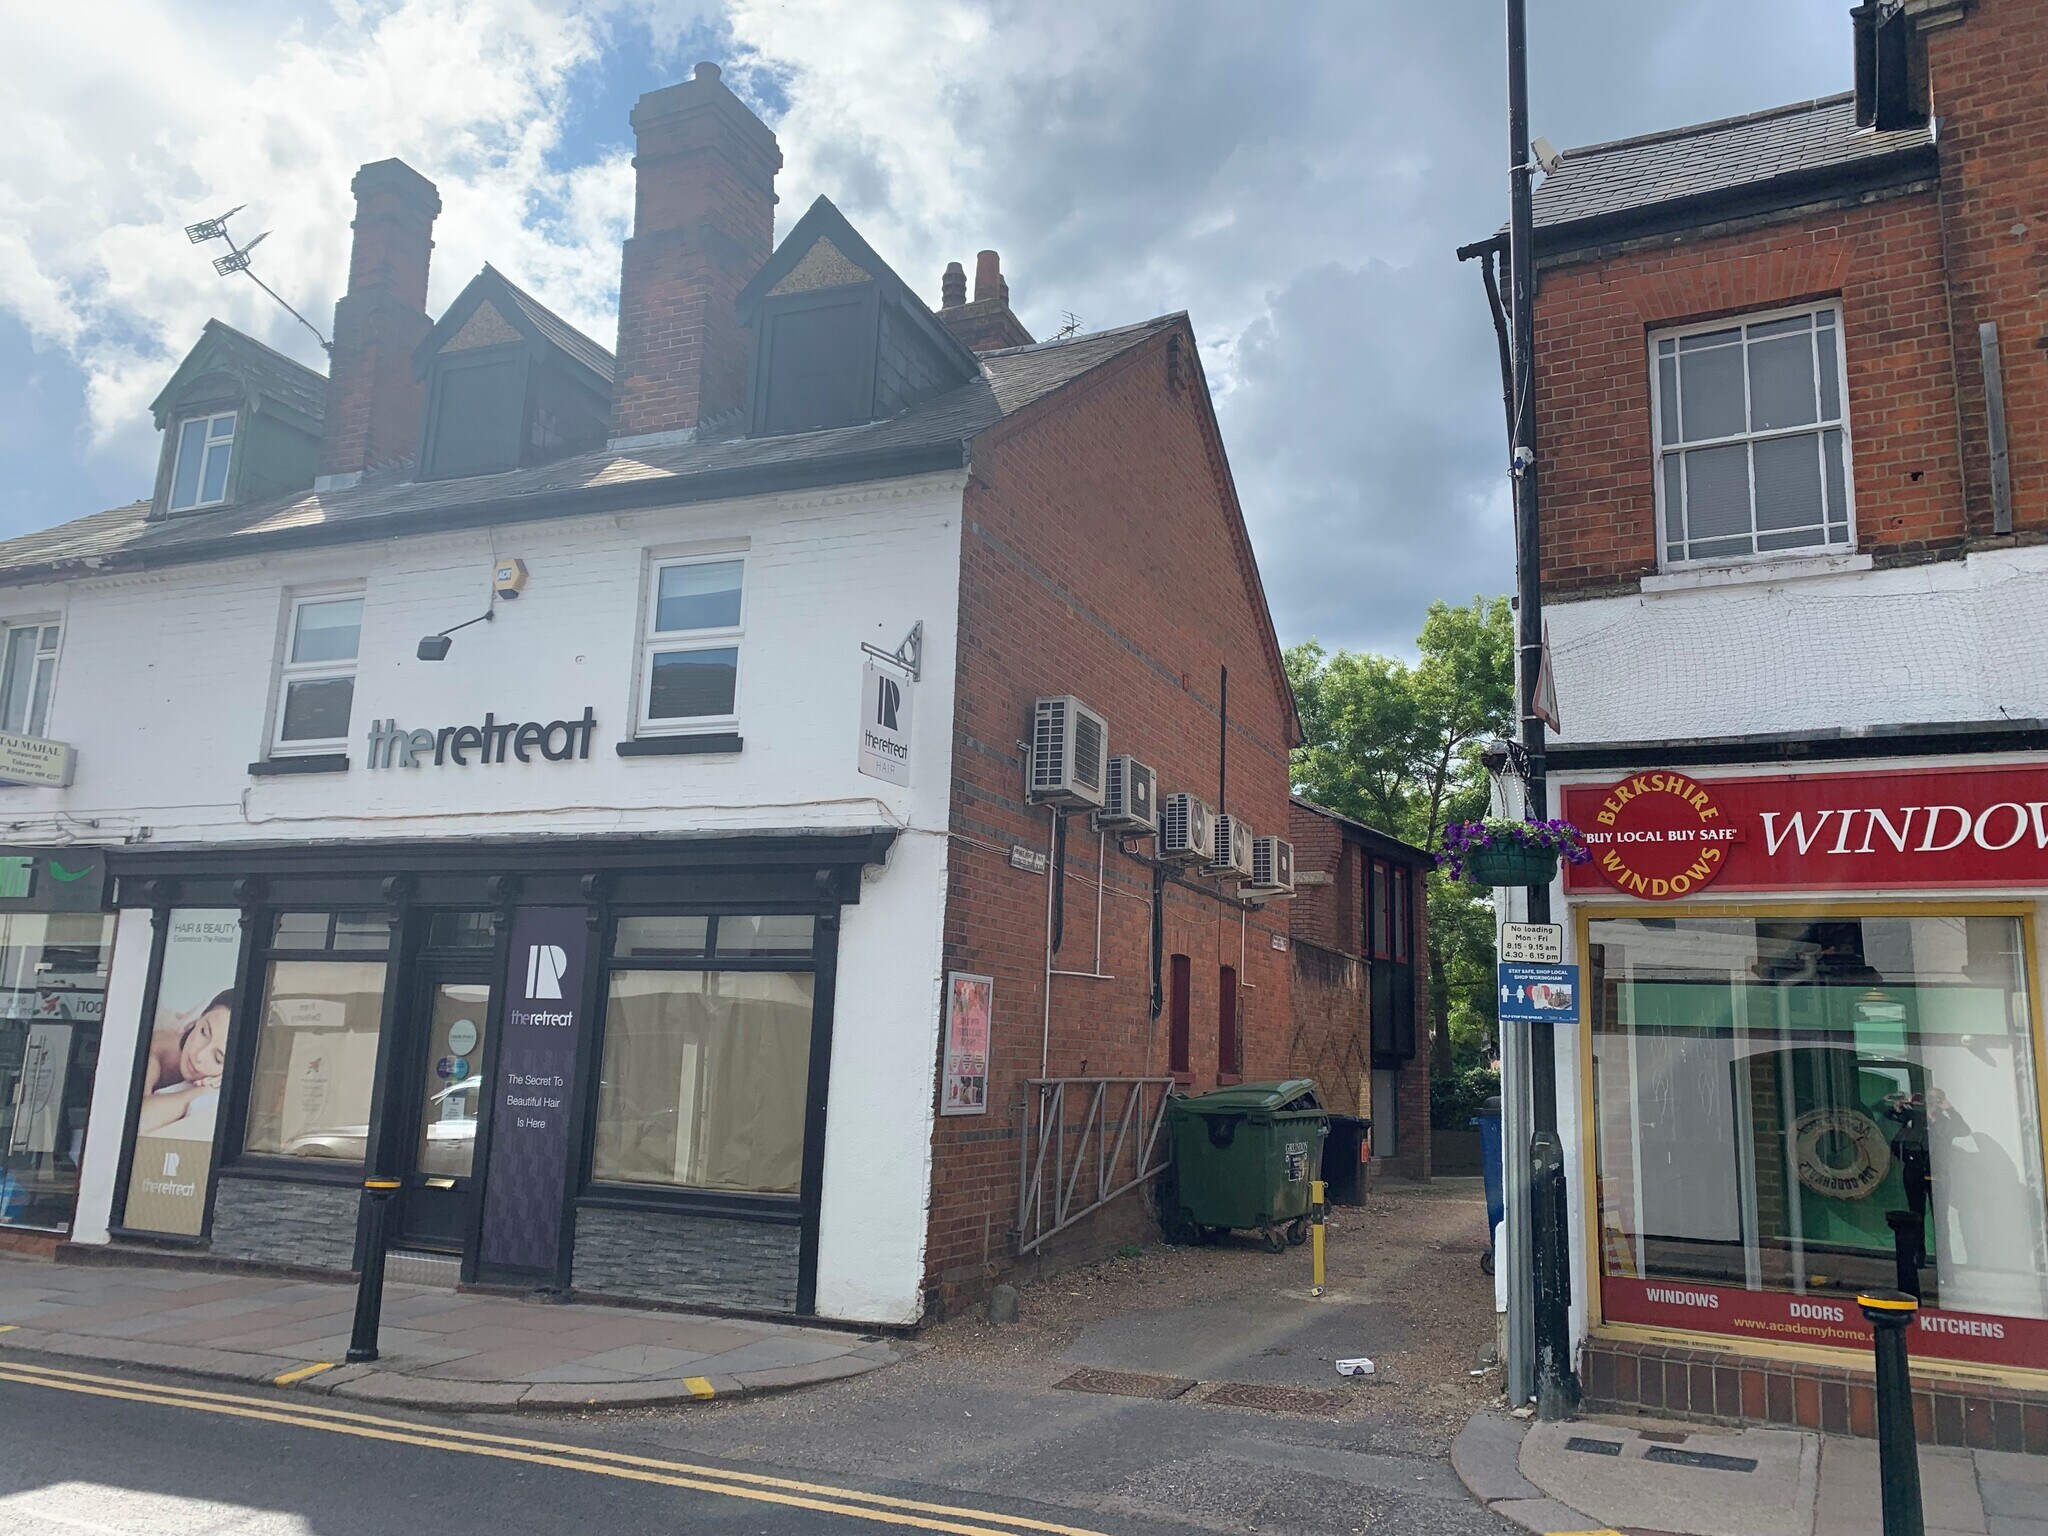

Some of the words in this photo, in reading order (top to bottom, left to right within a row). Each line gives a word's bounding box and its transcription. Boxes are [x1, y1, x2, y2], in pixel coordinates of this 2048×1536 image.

[496, 569, 512, 580] ADT
[0, 737, 18, 748] TAJ
[21, 740, 60, 756] MAHAL
[7, 748, 42, 760] Restaurant
[12, 758, 42, 769] Takeaway
[875, 760, 896, 776] HAIR
[1597, 774, 1719, 826] BERKSHIRE
[1617, 831, 1664, 843] LOCAL
[1668, 830, 1696, 842] BUY
[1602, 846, 1721, 897] WINDOWS
[175, 923, 195, 933] HAIR
[195, 923, 202, 934] &
[203, 923, 237, 934] BEAUTY
[1524, 925, 1553, 934] loading
[1528, 943, 1543, 951] 9.15
[1505, 951, 1523, 959] 4.30
[1529, 952, 1545, 960] 6.15
[508, 1074, 523, 1085] The
[525, 1074, 551, 1087] Secret
[553, 1076, 564, 1087] To
[507, 1095, 542, 1107] Beautiful
[543, 1097, 560, 1108] Hair
[517, 1117, 524, 1127] Is
[526, 1117, 546, 1129] Here
[1645, 1287, 1719, 1309] WINDOWS
[1790, 1303, 1844, 1322] DOORS
[1920, 1316, 2005, 1339] KITCHENS
